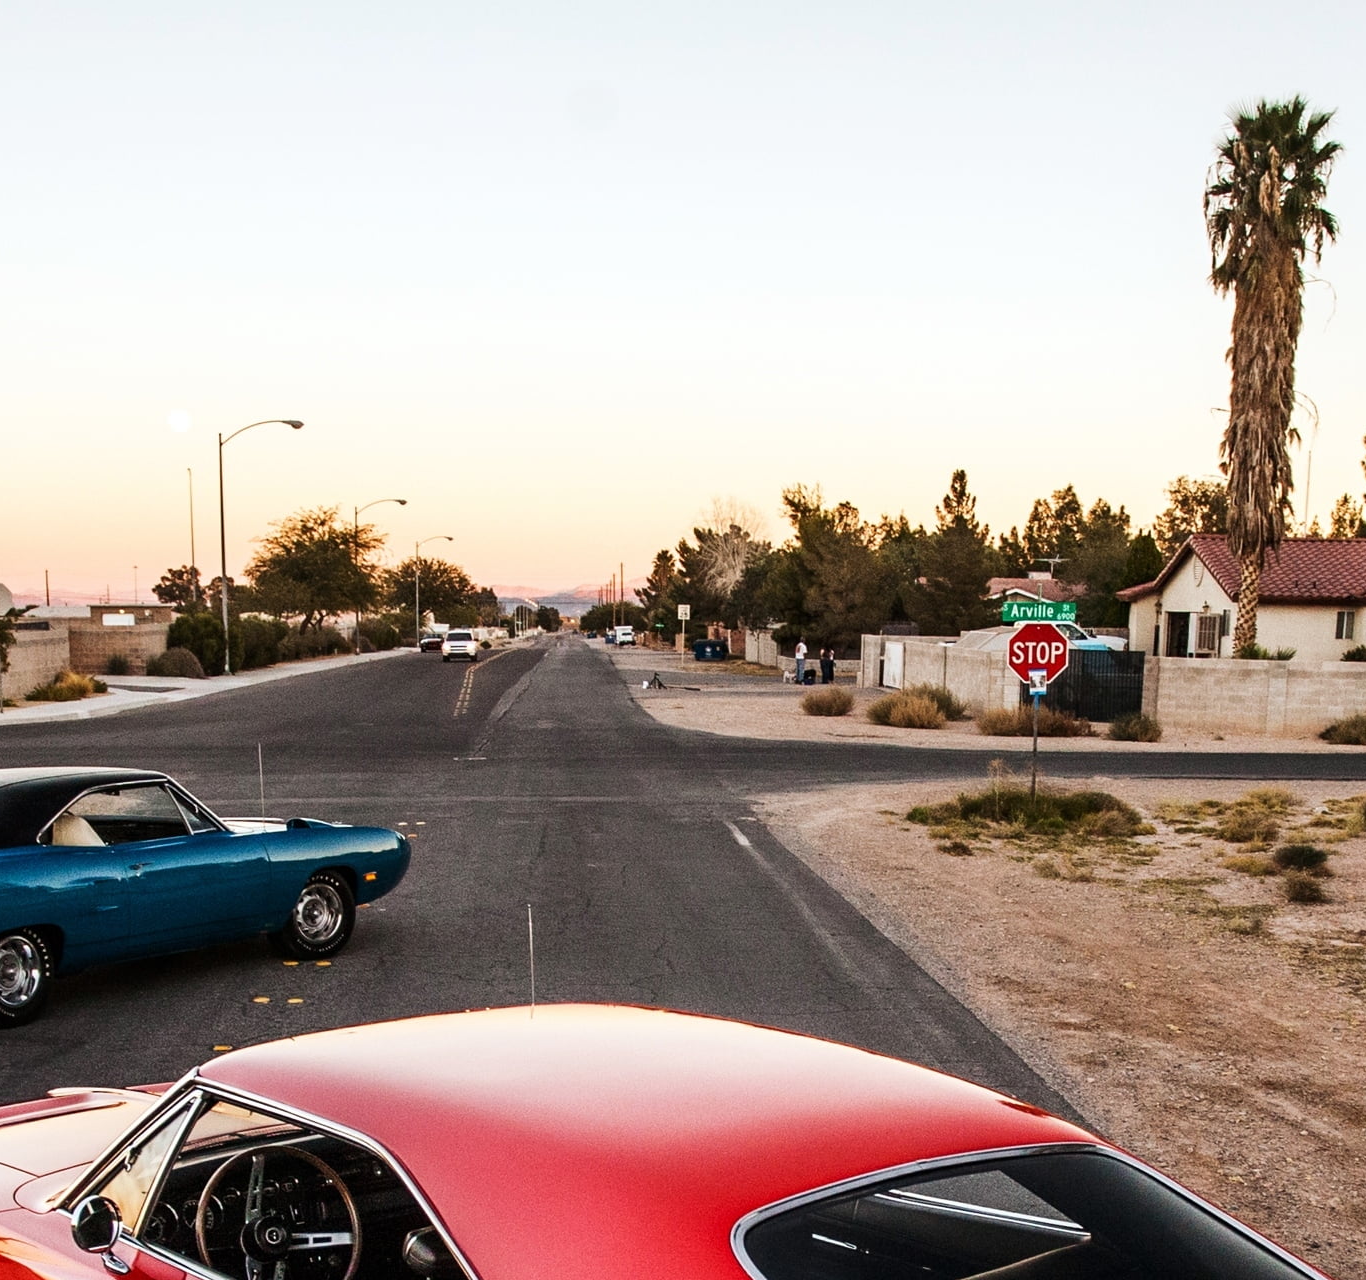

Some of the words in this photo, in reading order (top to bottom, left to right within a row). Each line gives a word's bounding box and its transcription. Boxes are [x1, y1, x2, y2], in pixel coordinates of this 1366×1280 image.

[1010, 604, 1054, 618] Arville
[1056, 612, 1075, 620] 6900
[1011, 641, 1064, 664] STOP
